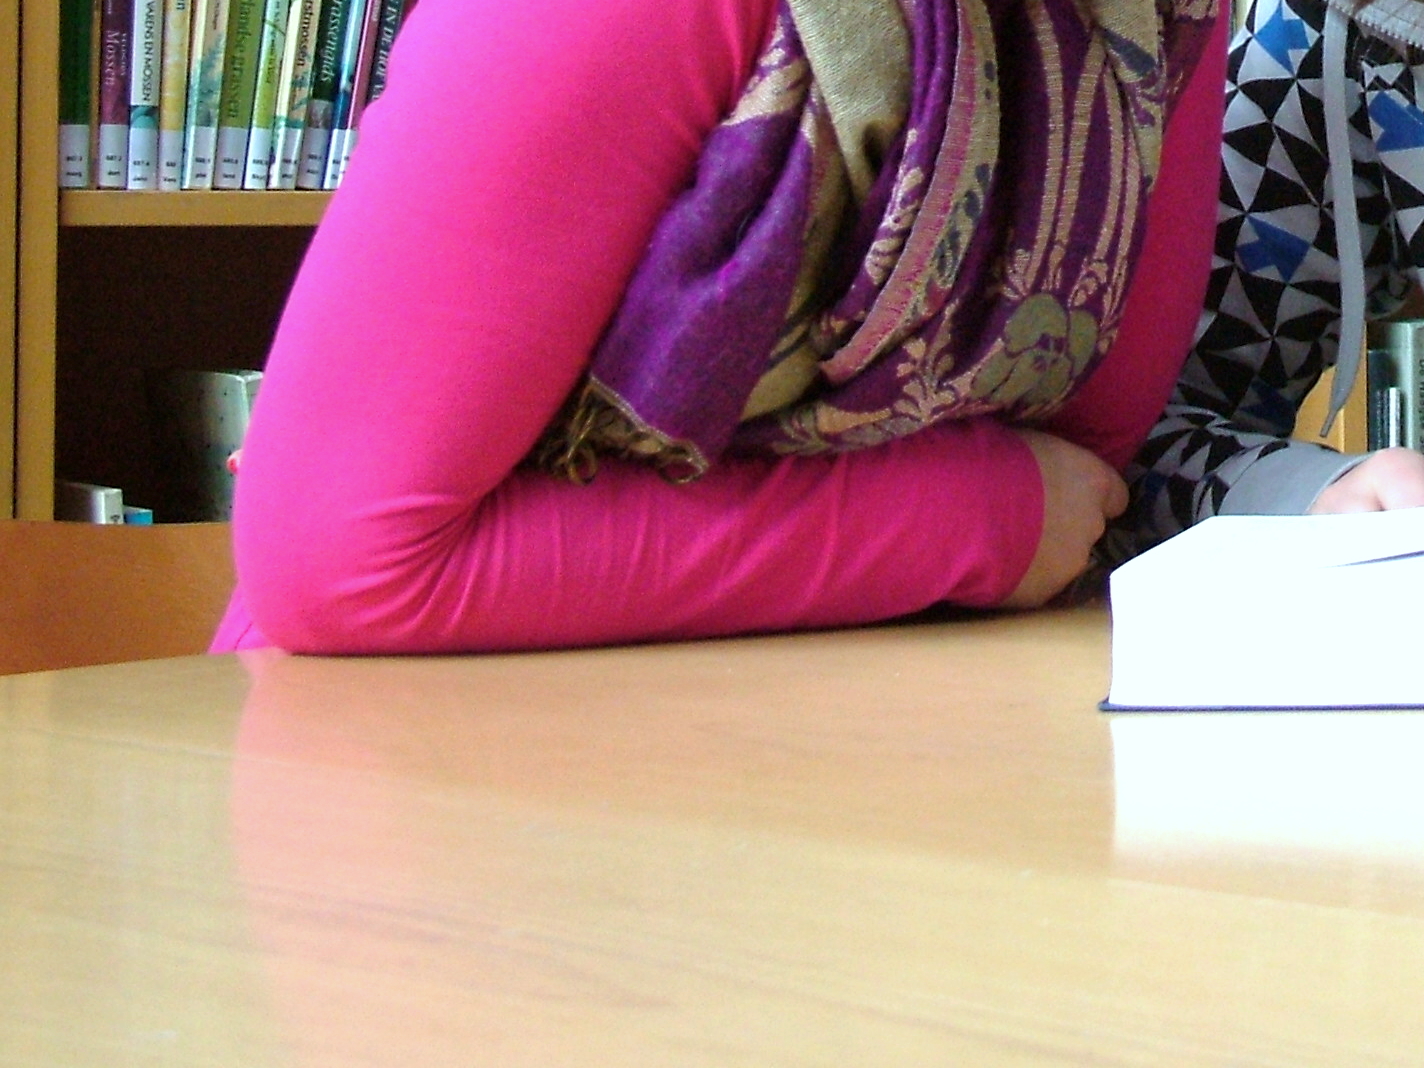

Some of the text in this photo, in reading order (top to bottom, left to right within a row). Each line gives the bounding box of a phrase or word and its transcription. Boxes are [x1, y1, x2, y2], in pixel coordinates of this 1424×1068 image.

[143, 1, 156, 40] VARENS
[384, 6, 400, 25] IN
[104, 30, 120, 87] Mossen
[143, 42, 154, 57] EN
[142, 58, 154, 102] MOSSEN
[227, 55, 248, 119] grassen
